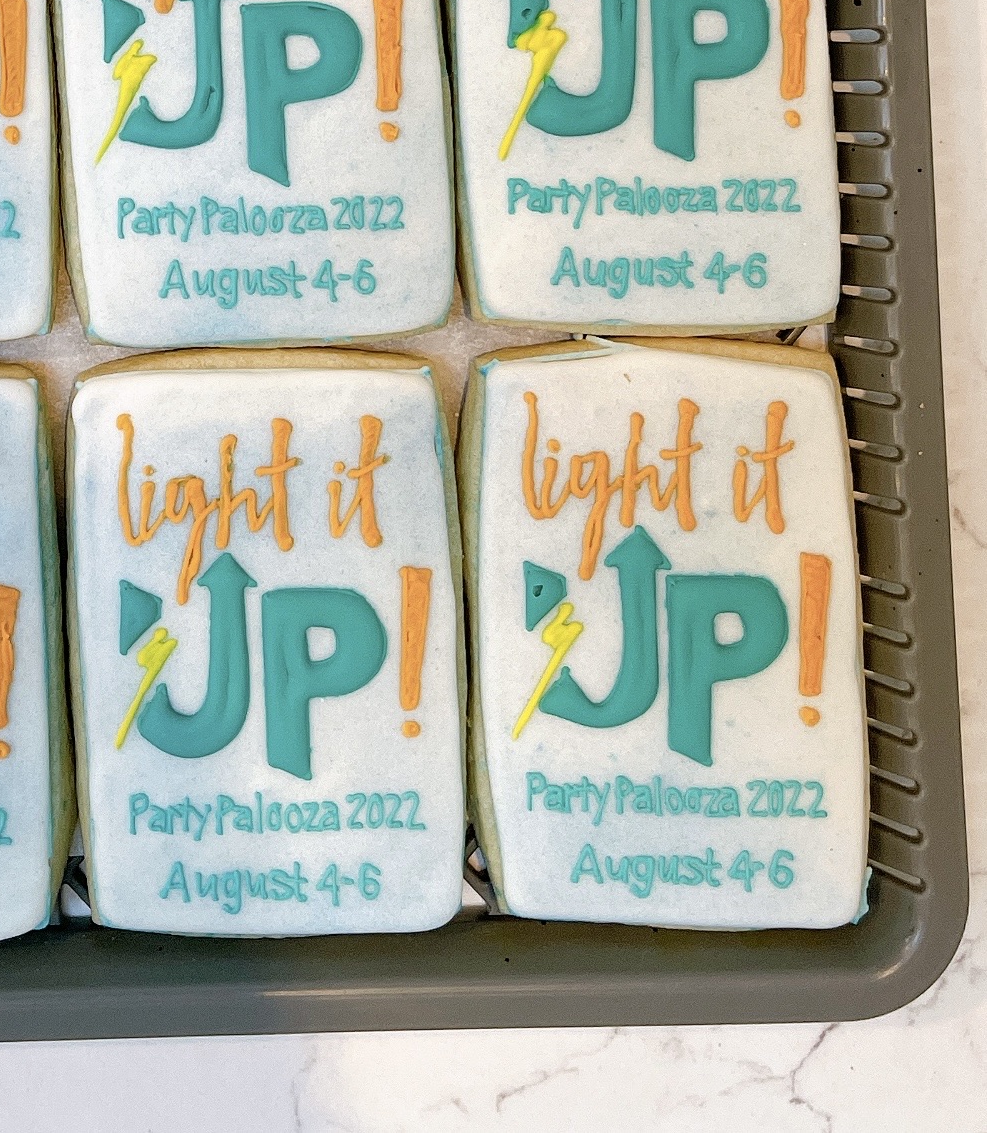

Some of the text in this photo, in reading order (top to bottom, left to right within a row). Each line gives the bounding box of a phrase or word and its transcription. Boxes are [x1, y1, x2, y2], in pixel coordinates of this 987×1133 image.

[116, 195, 405, 243] Party Palooza 2022
[506, 176, 802, 230] Party Palooza 2022
[158, 258, 376, 310] August 4-6
[550, 246, 768, 300] August 4-6
[329, 415, 386, 547] it
[733, 401, 797, 534] it
[128, 790, 426, 841] Party Palooza 2022
[526, 772, 828, 827] Party Palooza 2022
[159, 861, 382, 915] August 4-6
[570, 843, 795, 899] August 4-6
